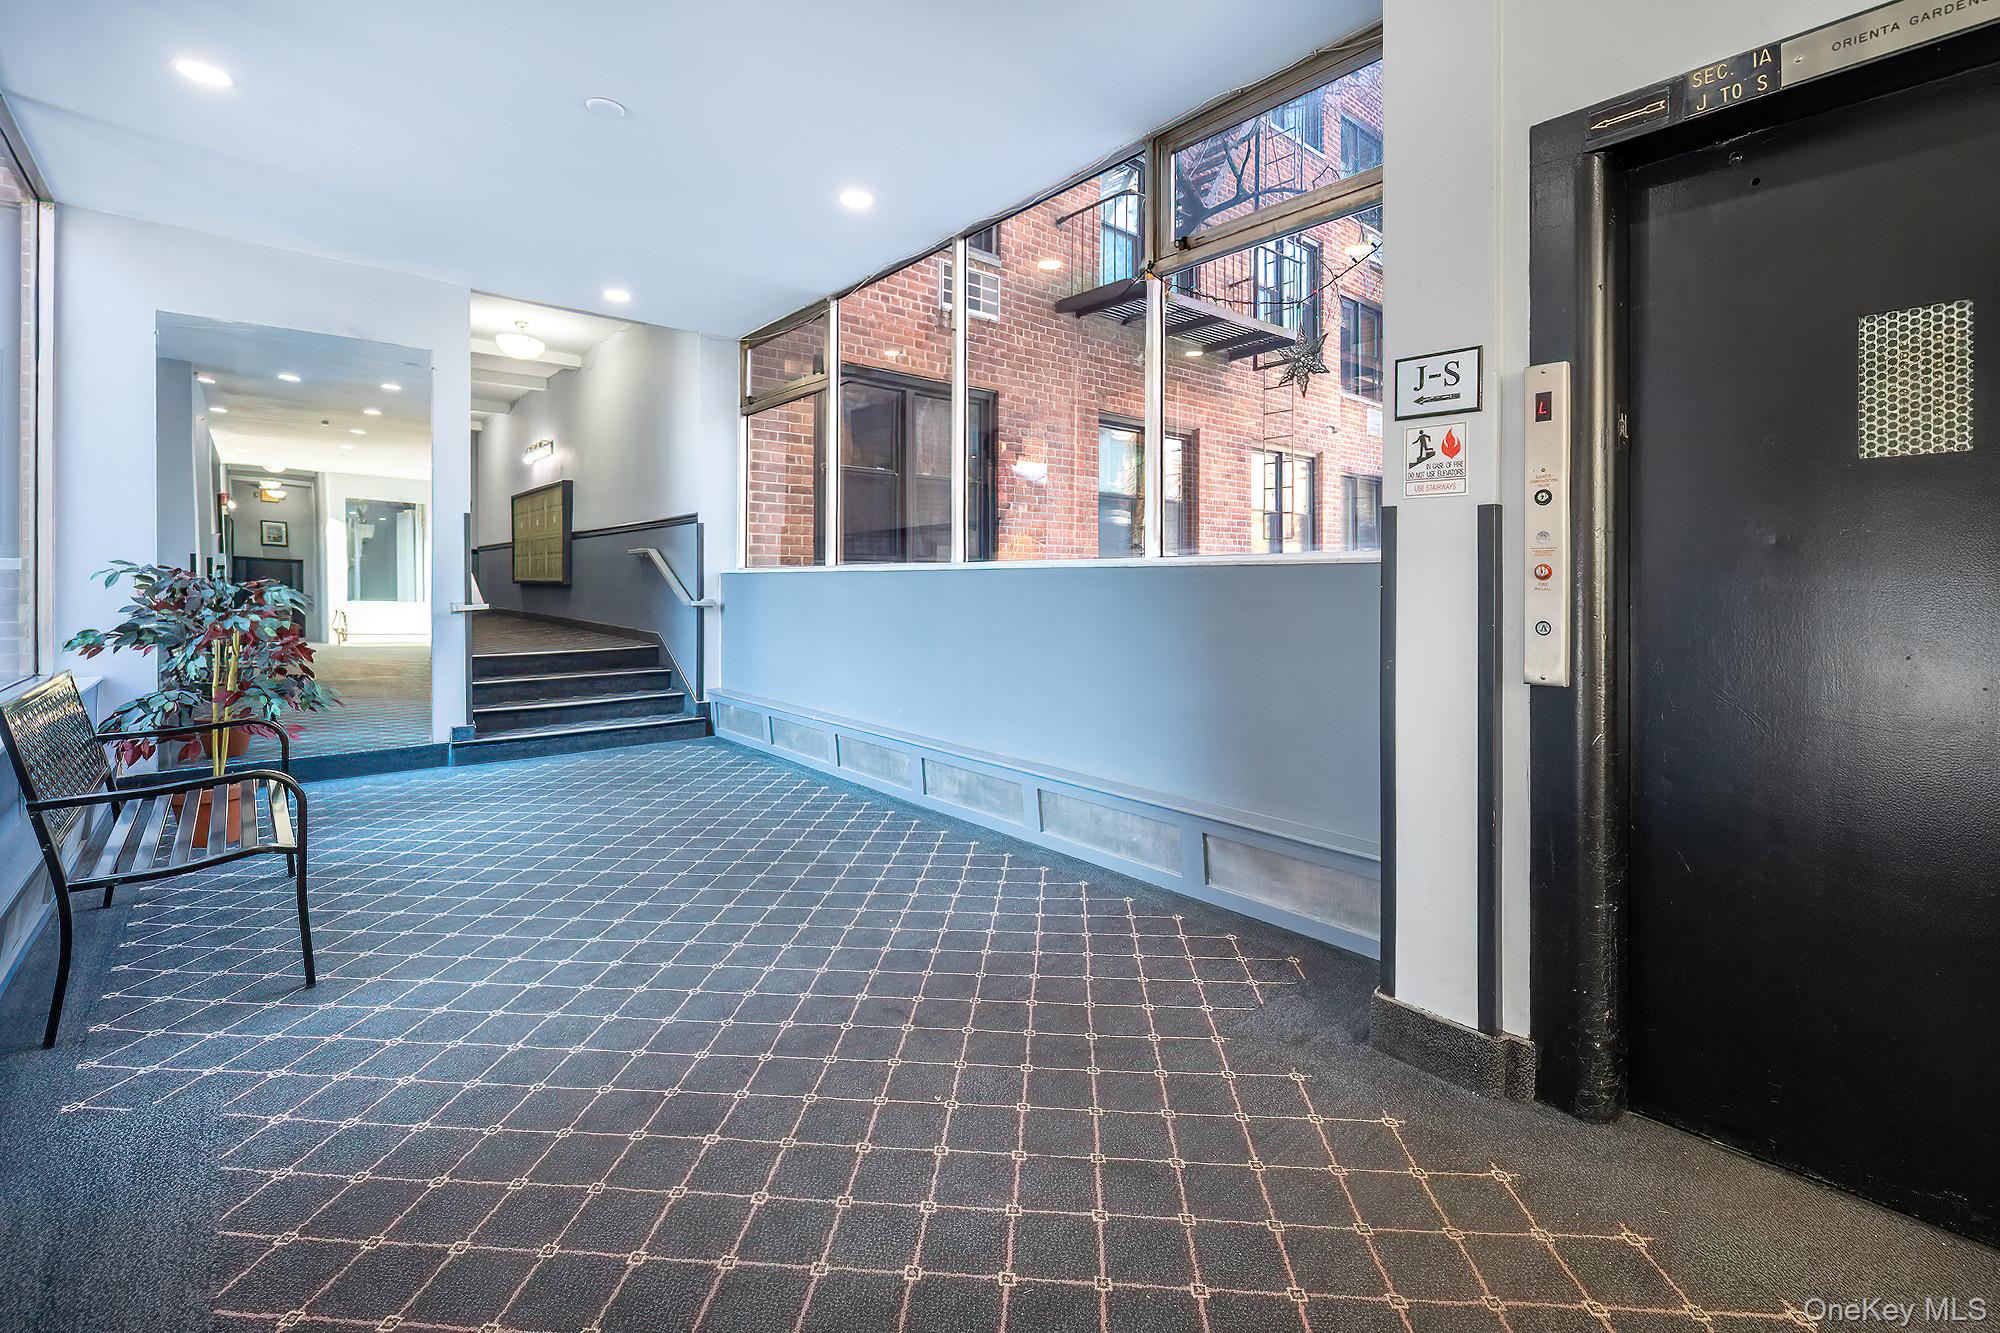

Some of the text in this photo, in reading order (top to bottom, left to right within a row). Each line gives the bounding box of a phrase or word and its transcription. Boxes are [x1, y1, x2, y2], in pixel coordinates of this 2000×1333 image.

[1831, 0, 1990, 52] ORIENTA GARDEN
[1692, 63, 1734, 88] SEC.
[1696, 74, 1768, 111] J TO S
[1413, 360, 1461, 392] J-S
[1408, 472, 1415, 480] DO
[1415, 471, 1425, 479] NOT
[1426, 470, 1436, 478] USE
[1432, 461, 1445, 470] CASE
[1446, 460, 1453, 469] OF
[1454, 460, 1464, 468] FIRE
[1414, 481, 1457, 493] USE STAIRWAYS
